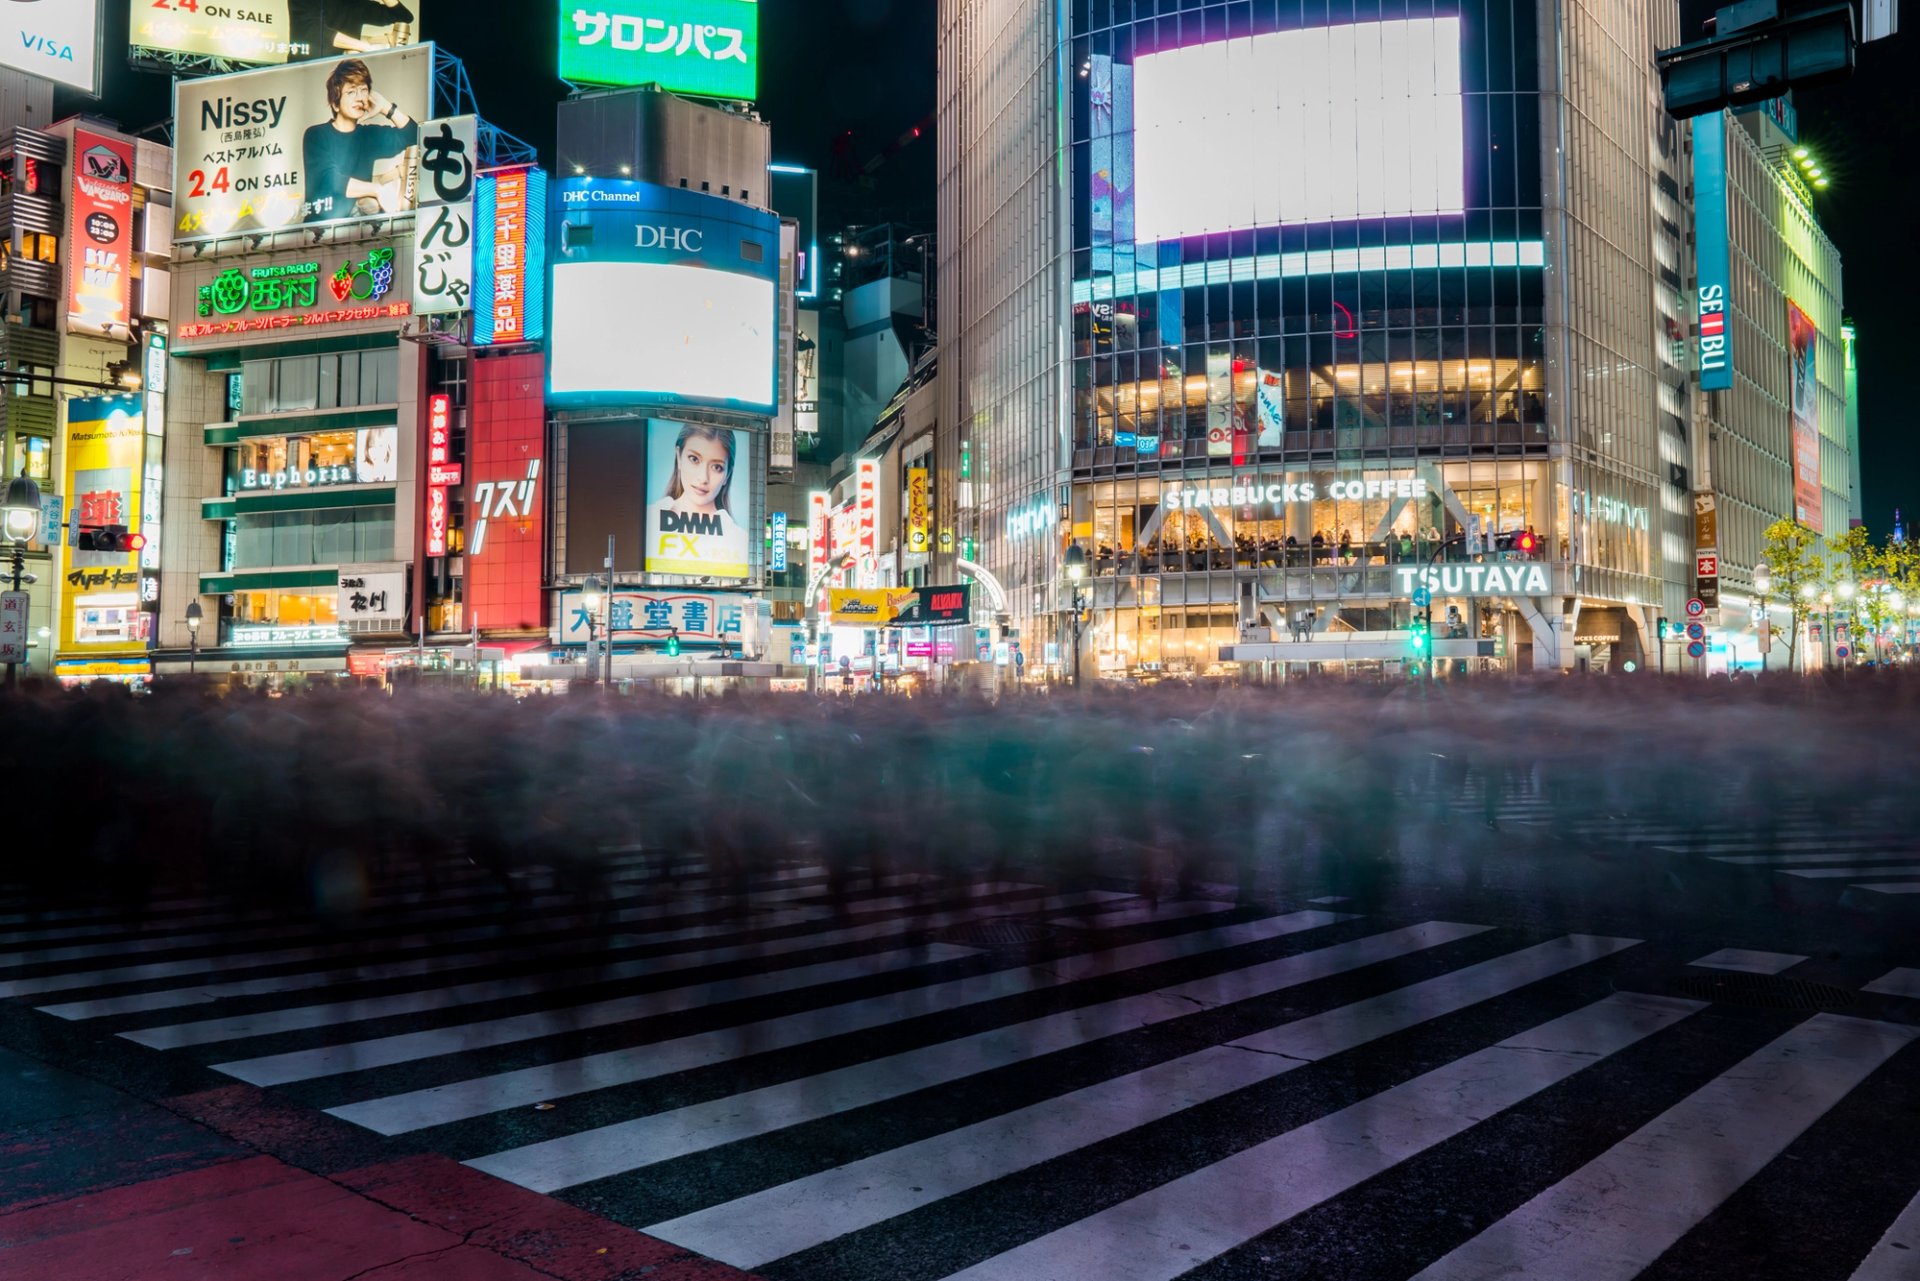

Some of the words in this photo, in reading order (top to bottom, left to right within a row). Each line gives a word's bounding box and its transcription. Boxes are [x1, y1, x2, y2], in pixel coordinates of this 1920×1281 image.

[205, 5, 231, 18] ON
[236, 10, 273, 24] SALE
[21, 30, 73, 62] VISA
[572, 8, 747, 64] サロンパス
[201, 96, 287, 131] Nissy
[203, 143, 283, 164] ベストアルバム
[188, 166, 230, 198] 2.4
[235, 177, 259, 192] ON
[264, 171, 298, 188] SALE
[404, 165, 418, 203] Nissy
[563, 191, 590, 202] DHC
[591, 190, 640, 202] Channel
[418, 123, 472, 306] もんじゃ
[635, 224, 703, 252] DHC
[495, 180, 519, 332] 三千里薬品
[251, 275, 318, 311] 西村
[1699, 284, 1726, 371] SEIBU
[71, 430, 117, 441] Matsumoto
[244, 465, 352, 489] Euphoria
[470, 459, 541, 555] クスリ
[1166, 482, 1315, 510] STARBUCKS
[1329, 478, 1427, 500] COFFEE
[660, 509, 723, 536] DMM
[658, 534, 700, 558] FX
[1397, 566, 1549, 594] TSUTAYA
[1700, 560, 1714, 574] 本
[350, 590, 388, 613] 松川
[570, 599, 743, 633] 大盛堂書店
[3, 599, 17, 655] 道玄坂
